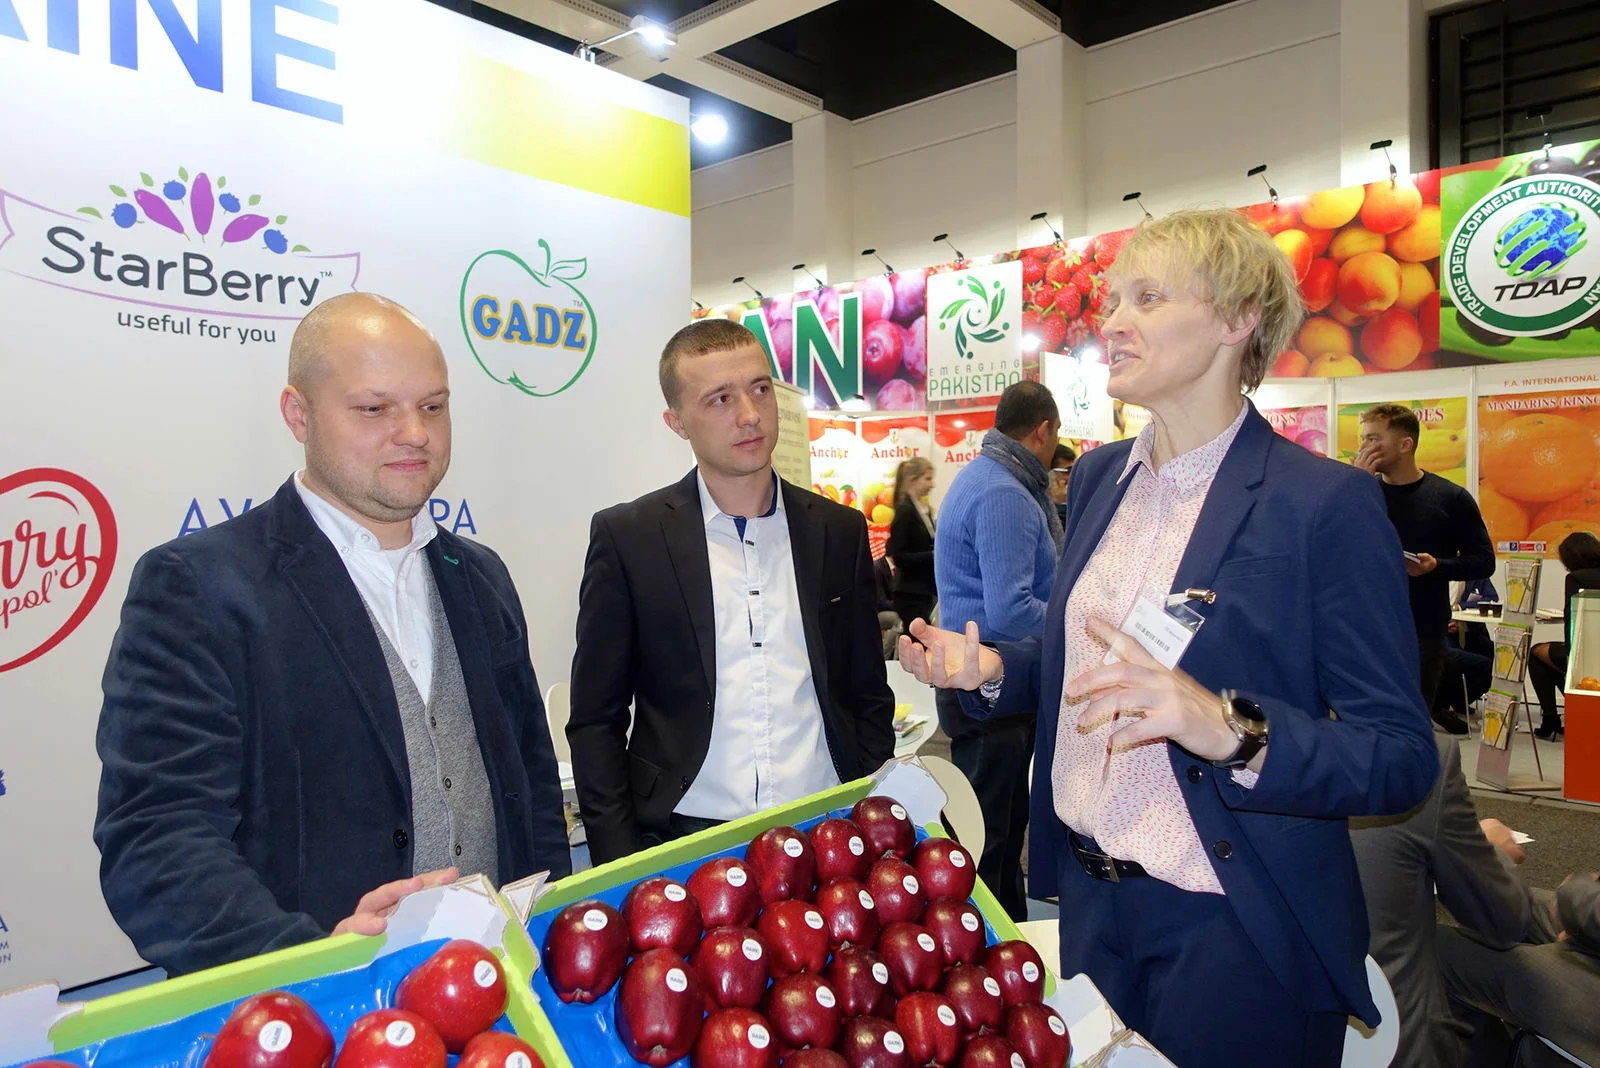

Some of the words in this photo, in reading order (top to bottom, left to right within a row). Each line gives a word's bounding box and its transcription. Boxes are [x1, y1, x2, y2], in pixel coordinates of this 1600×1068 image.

[0, 0, 344, 125] NE
[1525, 181, 1600, 214] AUTHORIT
[1452, 187, 1522, 275] DEVELOPMENT
[42, 226, 320, 306] StarBerry
[1452, 278, 1485, 317] TRADE
[1494, 276, 1587, 302] TDAP
[117, 312, 191, 335] useful
[198, 319, 232, 338] for
[237, 328, 276, 345] you
[470, 294, 588, 352] GADZ
[929, 360, 1020, 377] EMERGING
[1522, 374, 1599, 387] INTERNATIONAL
[929, 371, 1020, 397] PAKISTAN
[1486, 398, 1558, 412] MANDARINS
[809, 446, 849, 460] Anchor
[871, 446, 919, 459] Anchor
